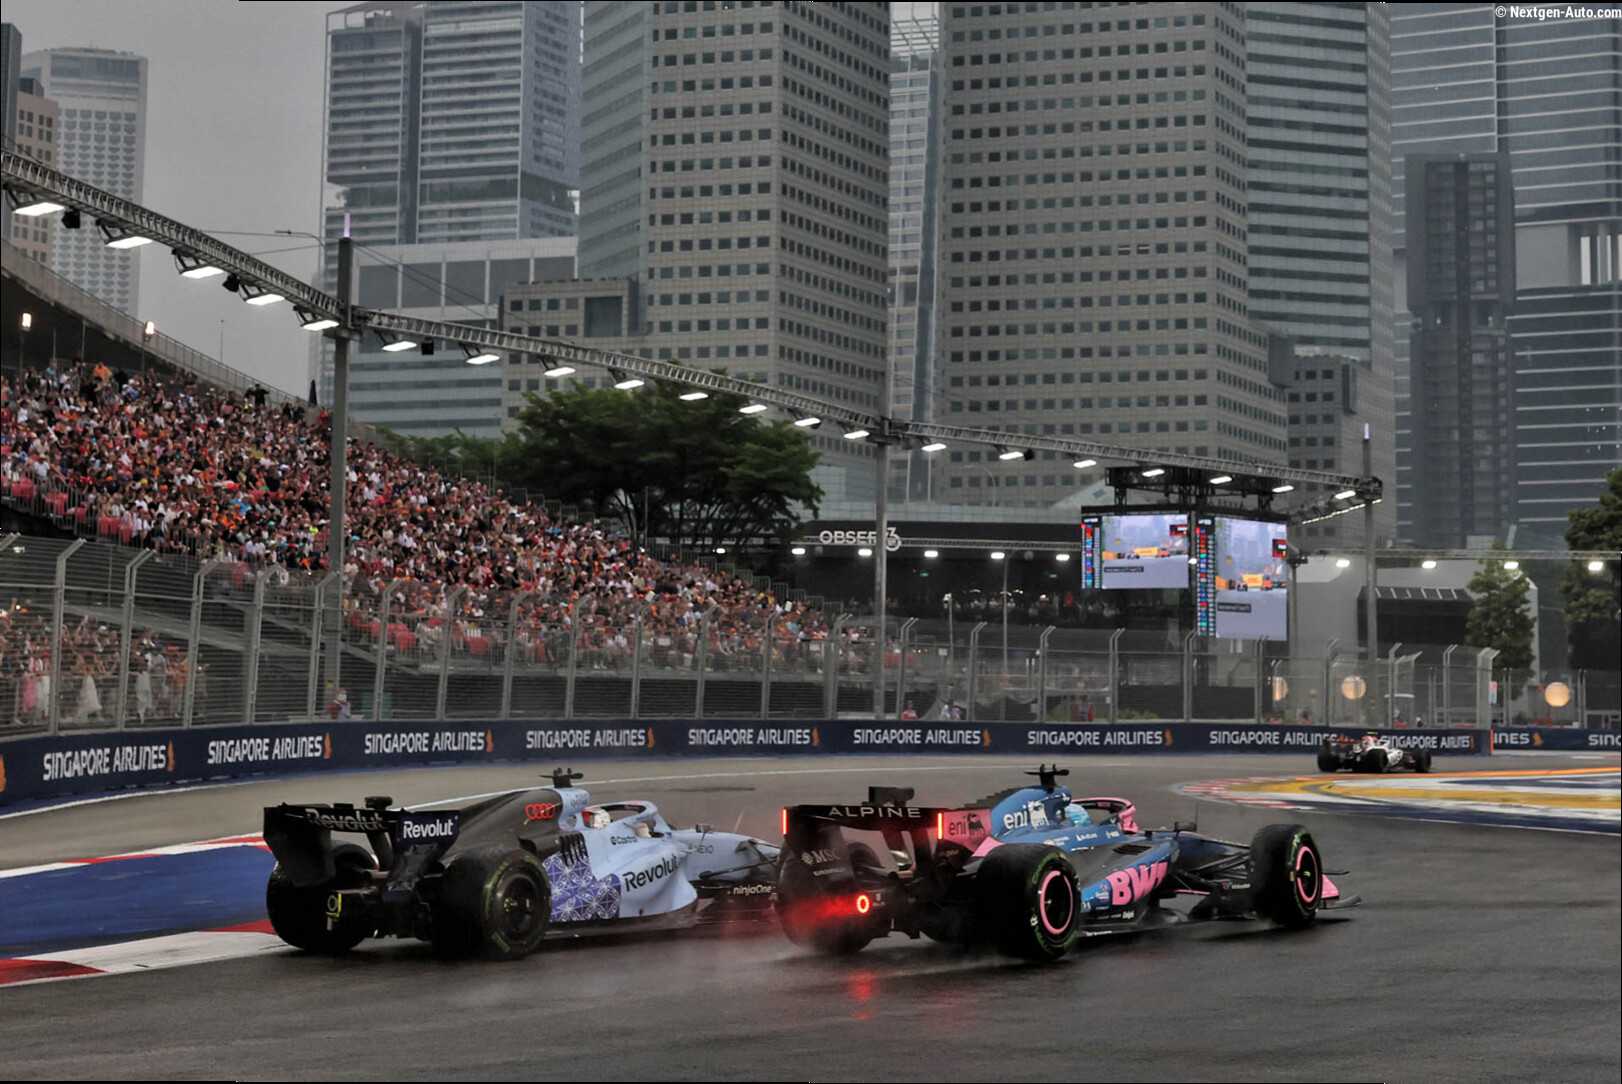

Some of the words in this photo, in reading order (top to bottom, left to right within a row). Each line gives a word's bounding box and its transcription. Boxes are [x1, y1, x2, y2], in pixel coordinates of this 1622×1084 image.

[364, 732, 430, 754] SINGAPORE
[432, 731, 485, 752] AIRLINES
[526, 730, 591, 748] SINGAPORE
[593, 729, 646, 748] AIRLINES
[688, 729, 754, 745] SINGAPORE
[756, 729, 811, 744] AIRLINES
[853, 729, 922, 744] SINGAPORE
[925, 729, 981, 745] AIRLINES
[1027, 730, 1101, 745] SINGAPORE
[1104, 730, 1163, 745] AIRLINES
[1209, 731, 1280, 745] SINGAPORE
[207, 738, 270, 764] SINGAPORE
[272, 736, 323, 760] AIRLINES
[43, 747, 111, 781] SINGAPORE
[112, 745, 167, 772] AIRLINES
[304, 808, 389, 831] Revolut
[829, 806, 922, 818] ALPINE
[1003, 804, 1028, 829] eni
[403, 818, 454, 839] Revolut
[948, 816, 967, 836] eni
[617, 835, 638, 845] Castrol
[622, 853, 678, 892] Revolut
[733, 884, 772, 896] ninjaOne
